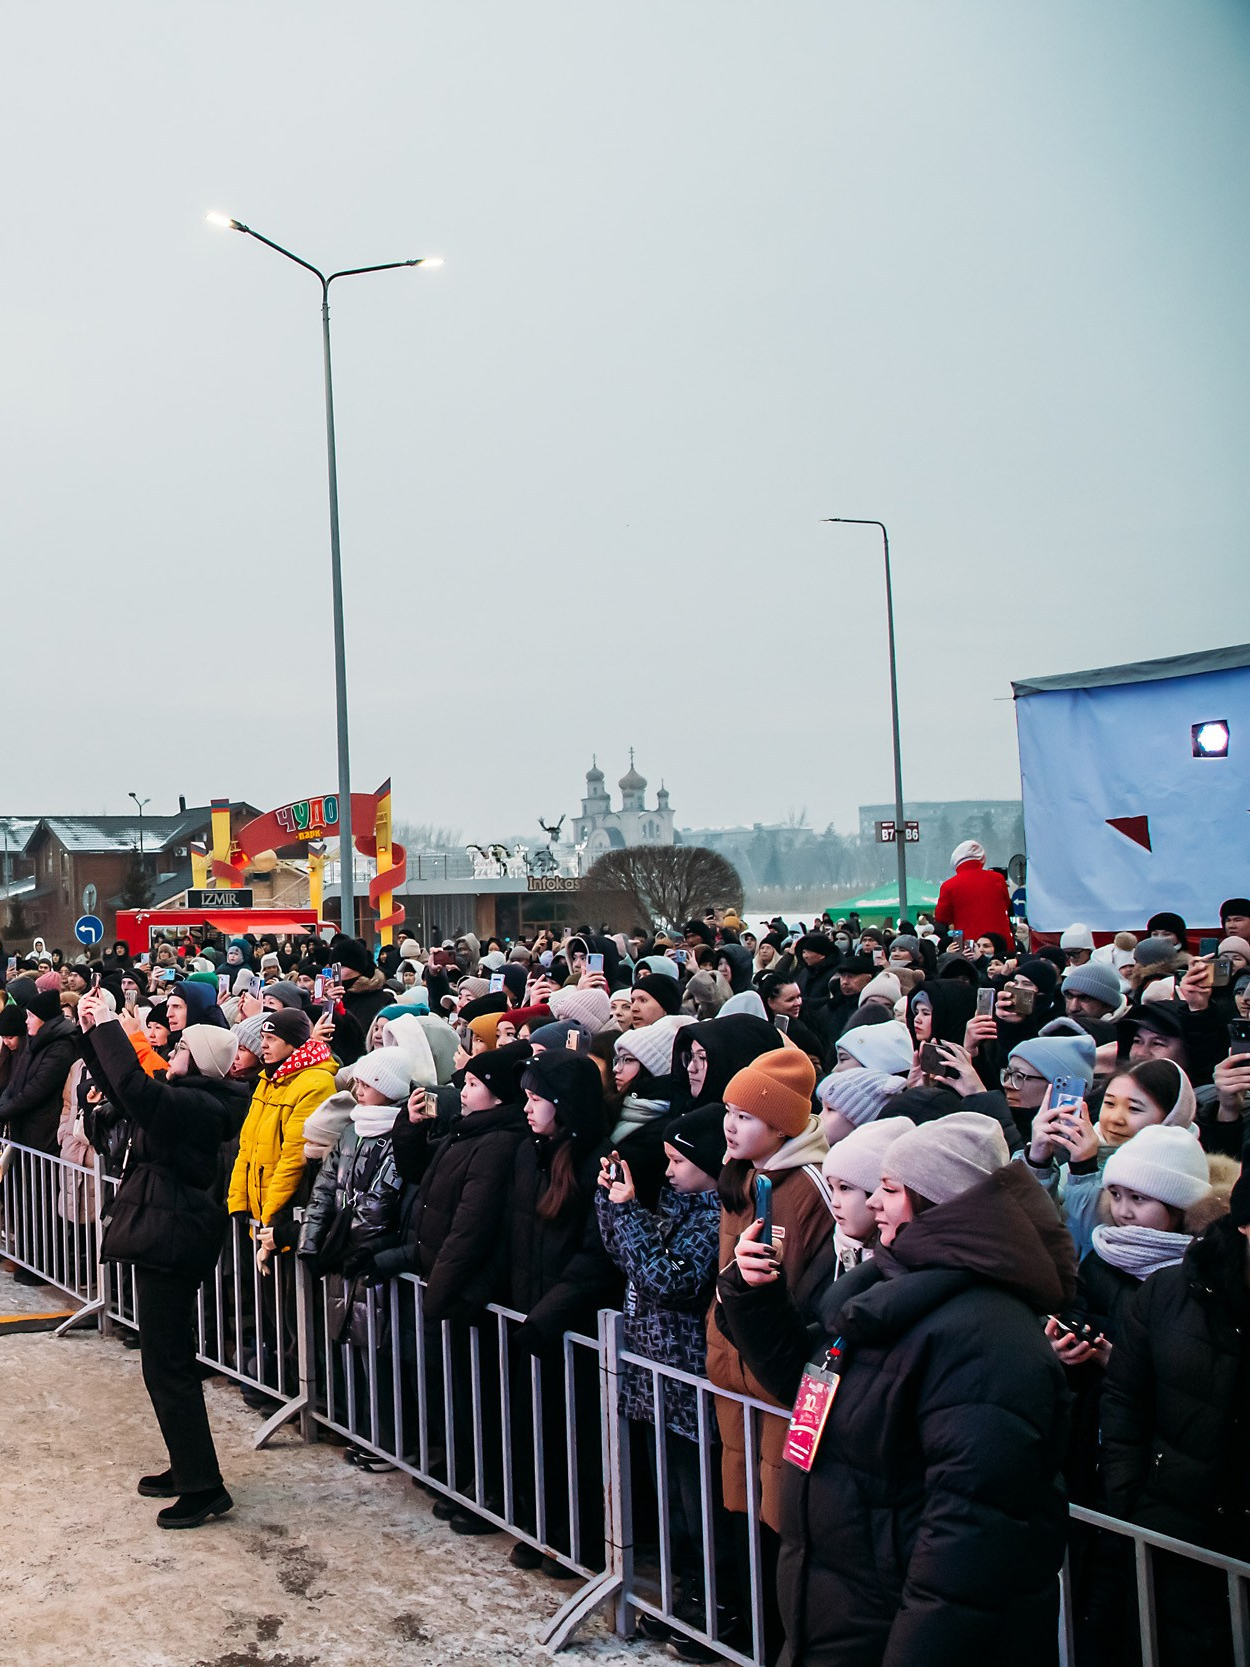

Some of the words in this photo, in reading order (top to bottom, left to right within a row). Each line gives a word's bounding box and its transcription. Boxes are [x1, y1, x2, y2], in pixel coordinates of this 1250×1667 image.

[276, 796, 339, 833] ЧУДО
[528, 876, 583, 890] Infokas
[201, 893, 240, 905] IZMIR
